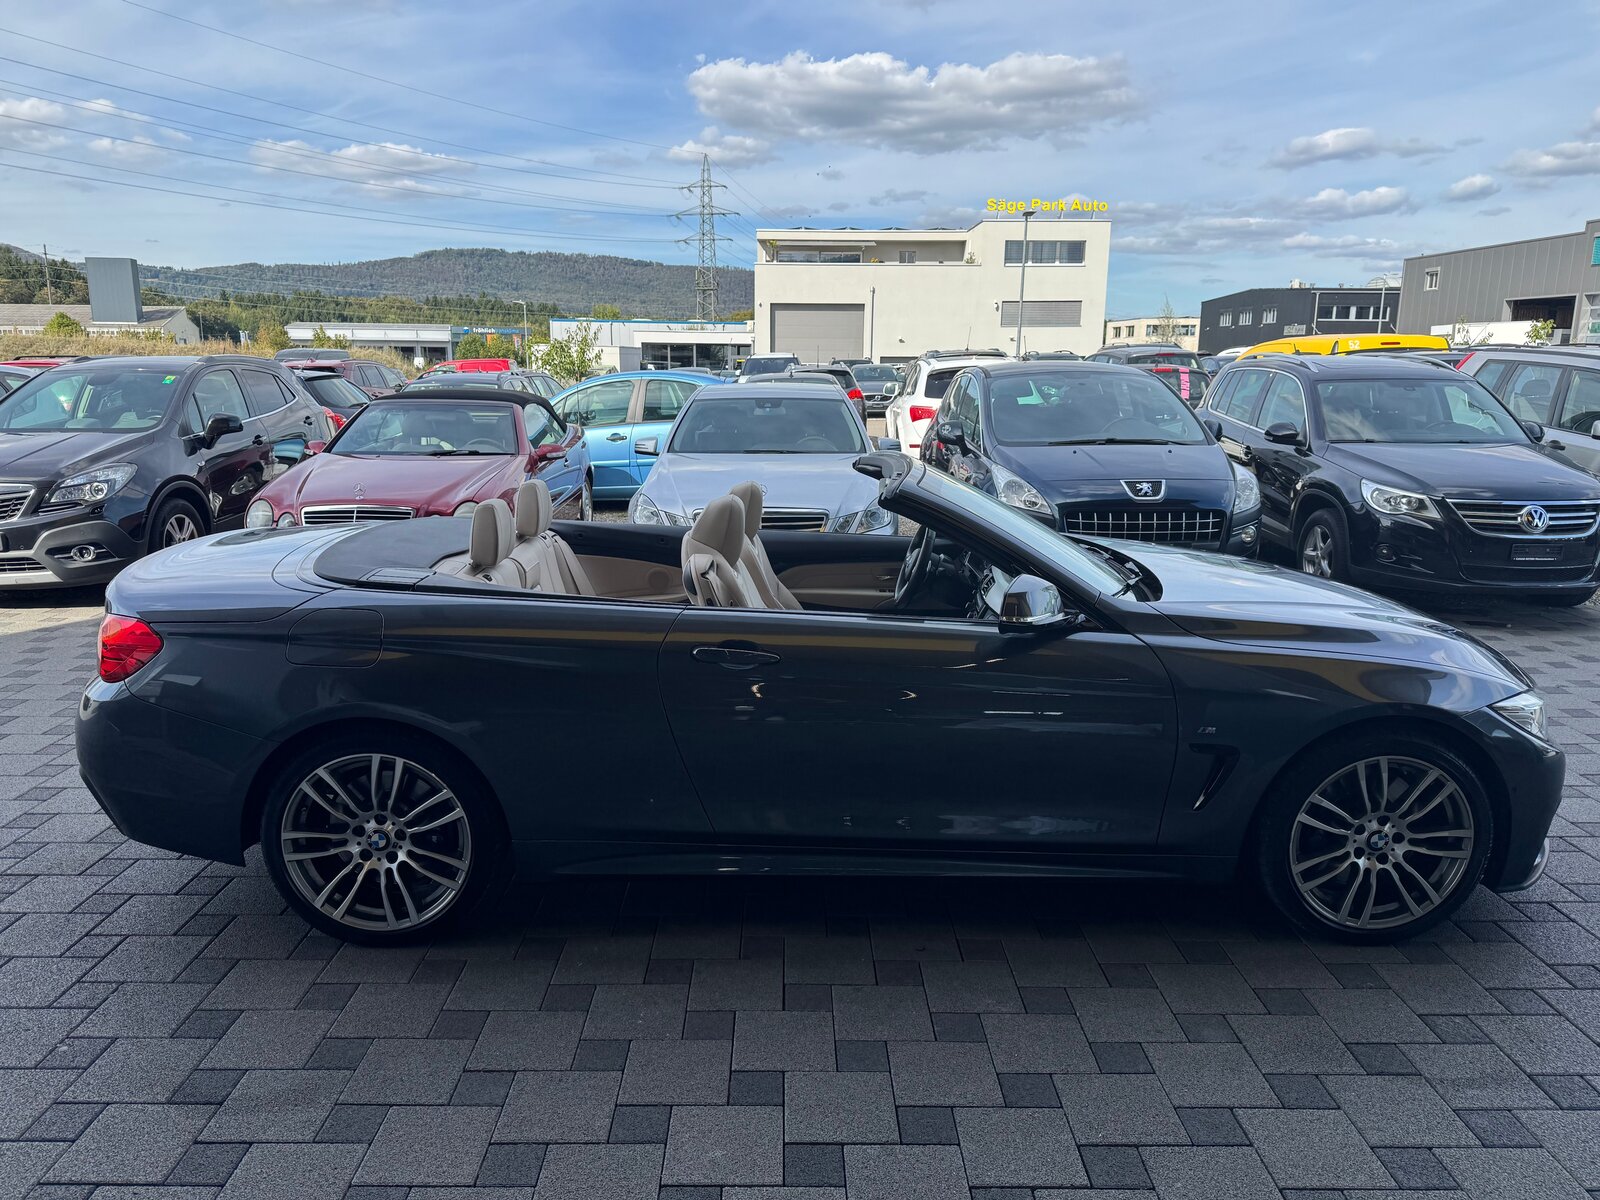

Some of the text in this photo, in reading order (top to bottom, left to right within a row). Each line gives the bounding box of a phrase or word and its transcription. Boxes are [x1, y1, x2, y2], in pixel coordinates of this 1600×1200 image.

[986, 198, 1109, 214] Säge Park Auto
